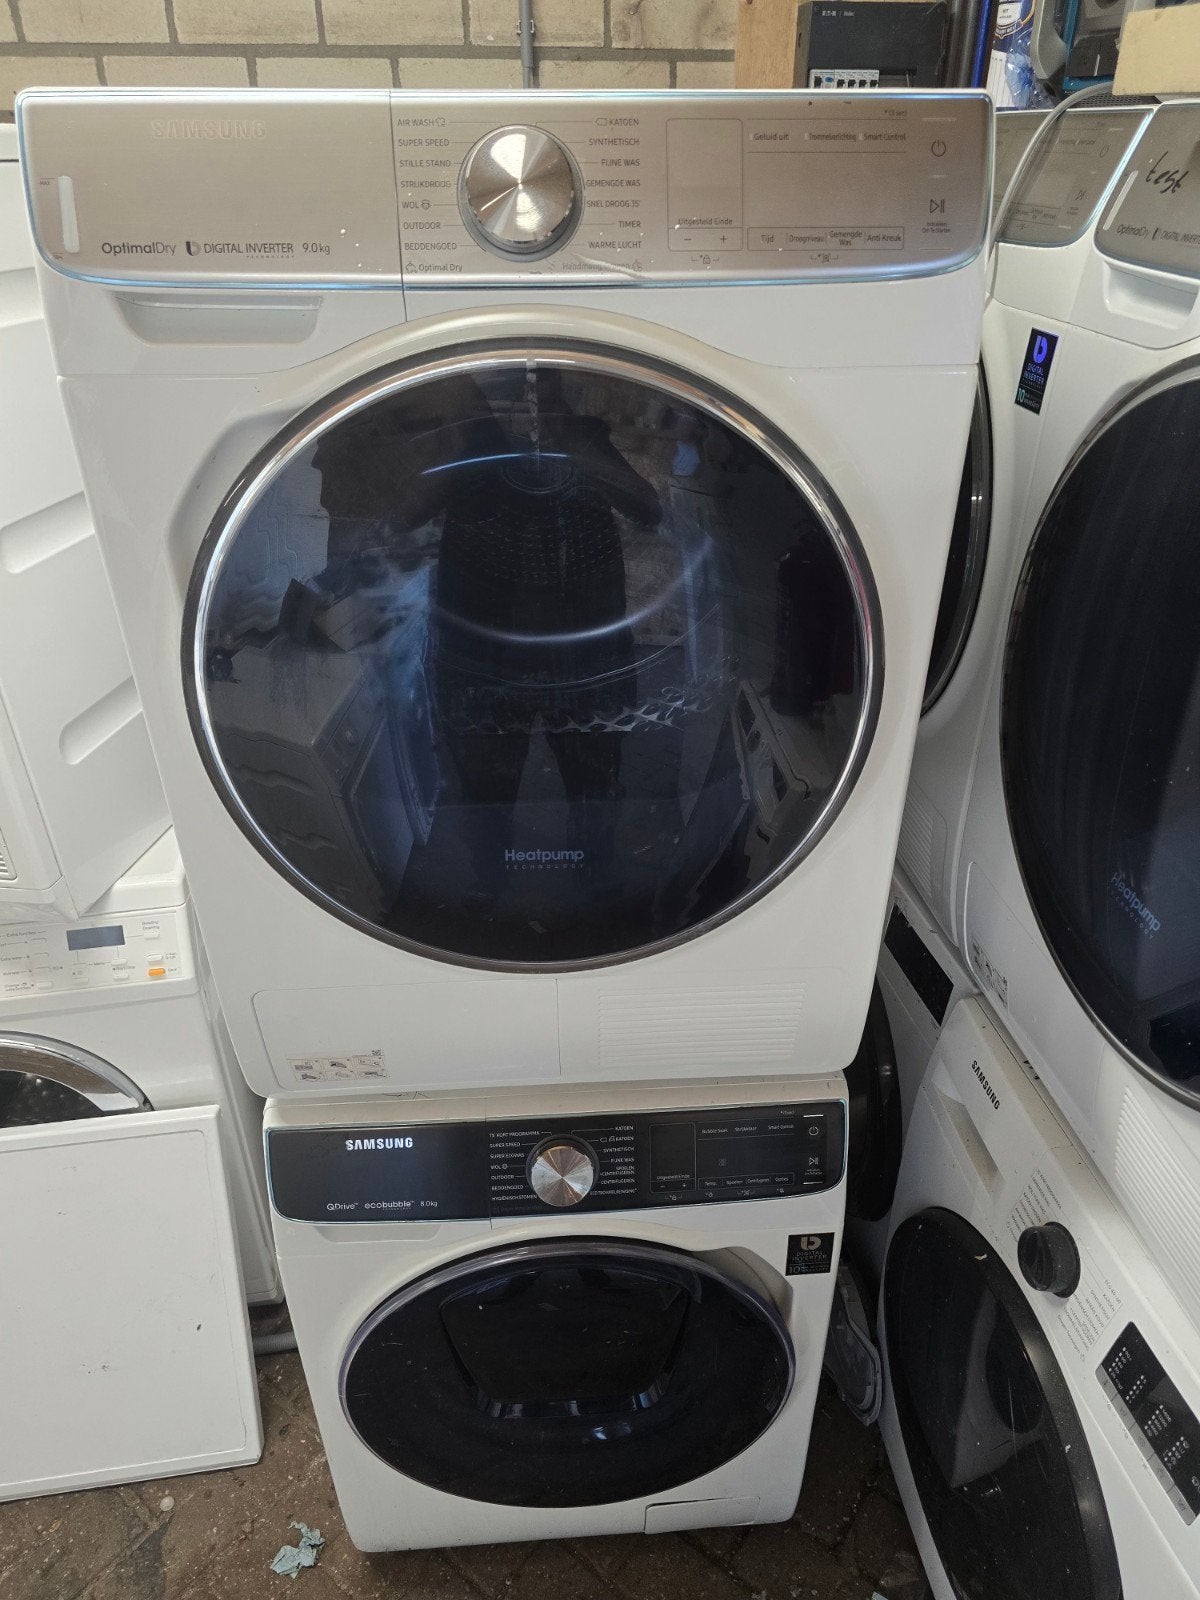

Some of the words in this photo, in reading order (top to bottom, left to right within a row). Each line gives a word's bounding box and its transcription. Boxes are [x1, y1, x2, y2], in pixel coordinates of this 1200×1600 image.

[609, 118, 638, 126] KATOEN
[151, 119, 266, 139] SAMSUNG
[754, 133, 777, 141] Geluid
[778, 133, 789, 141] uit
[864, 133, 882, 141] Smart
[883, 133, 905, 141] Control
[602, 159, 622, 167] FIJNE
[1146, 151, 1188, 194] test
[401, 180, 450, 188] STRIJKDROOG
[678, 218, 711, 226] Uitgesteld
[713, 218, 733, 226] Einde
[761, 235, 774, 243] Tijd
[829, 231, 862, 239] Gemengde
[102, 242, 176, 256] OptimalDry
[204, 243, 243, 254] DIGITAL
[246, 243, 294, 254] INVERTER
[405, 242, 457, 250] BEDDENGOED
[419, 263, 448, 272] Optimal
[450, 264, 462, 272] Dry
[504, 849, 584, 862] Heatpump
[1110, 872, 1161, 931] Heatpump
[971, 1060, 1000, 1110] SAMSUNG
[346, 1137, 413, 1150] SAMSUNG
